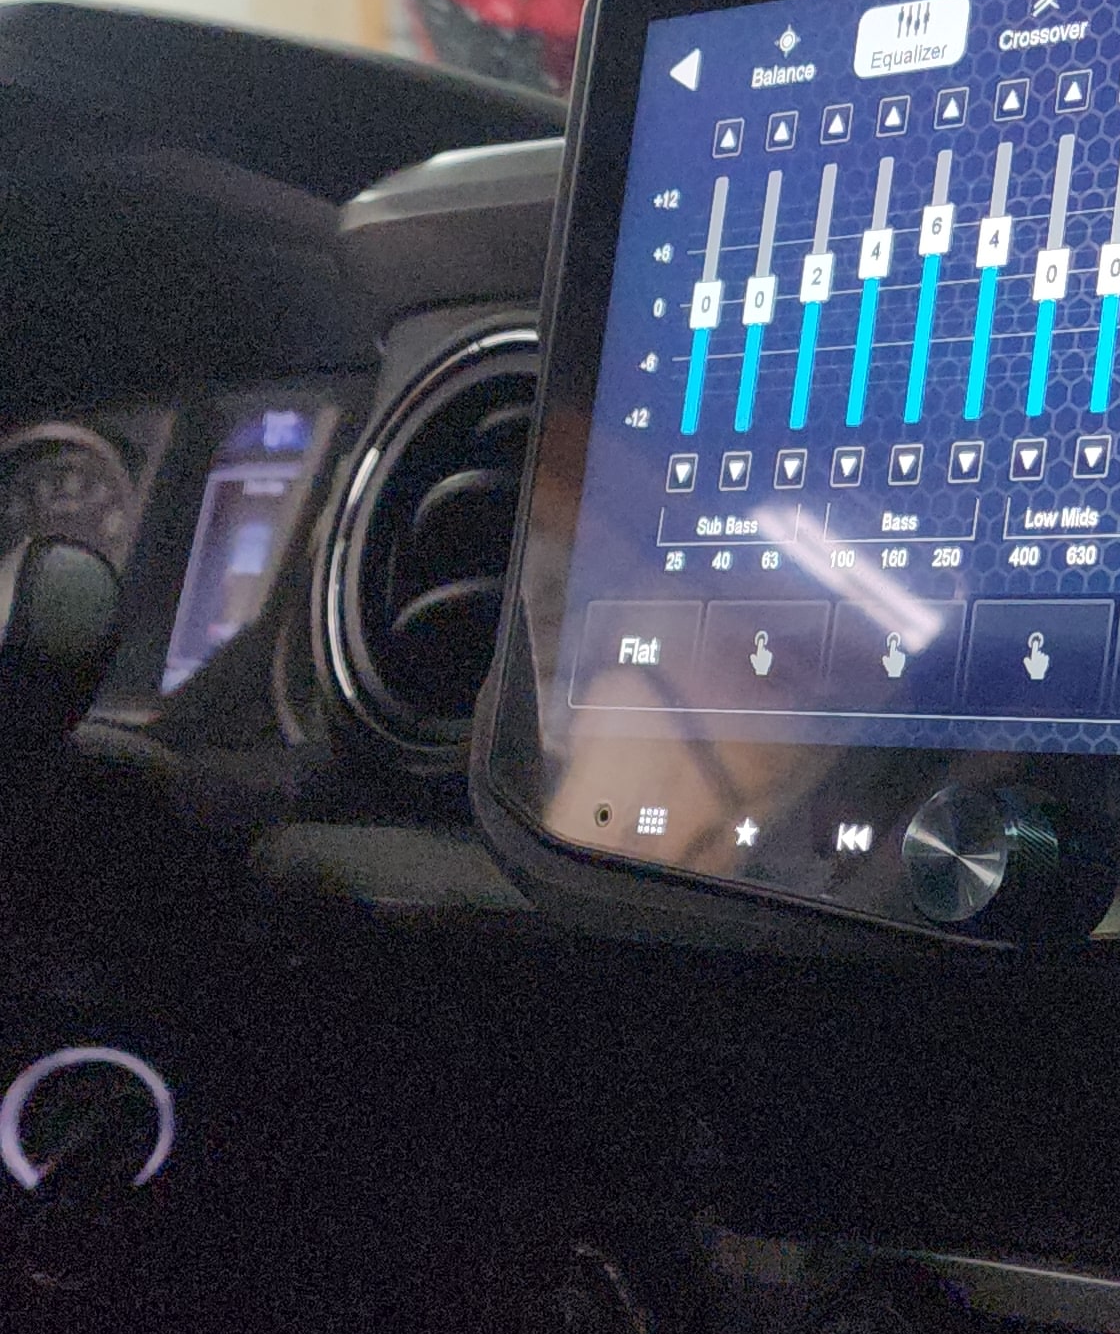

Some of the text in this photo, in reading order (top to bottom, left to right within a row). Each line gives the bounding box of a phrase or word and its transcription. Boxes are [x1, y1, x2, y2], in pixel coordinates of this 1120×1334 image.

[999, 21, 1088, 51] Crossover
[871, 44, 948, 71] Equalizer
[751, 63, 815, 89] Balance
[653, 189, 680, 210] +12
[931, 216, 943, 236] 6
[988, 228, 1000, 249] 4
[870, 241, 882, 261] 4
[810, 267, 823, 286] 2
[1045, 264, 1058, 284] 0
[654, 297, 667, 317] 0
[700, 294, 712, 314] 0
[754, 290, 765, 309] 0
[697, 514, 758, 535] Sub Bass
[882, 513, 918, 531] Bass
[1025, 507, 1098, 529] Low Mids
[665, 551, 685, 572] 25
[712, 551, 731, 570] 40
[761, 550, 780, 570] 63
[830, 549, 855, 568] 100
[881, 548, 907, 568] 160
[932, 548, 961, 567] 250
[1008, 546, 1040, 566] 400
[1066, 545, 1097, 565] 630
[619, 636, 660, 666] Flat
